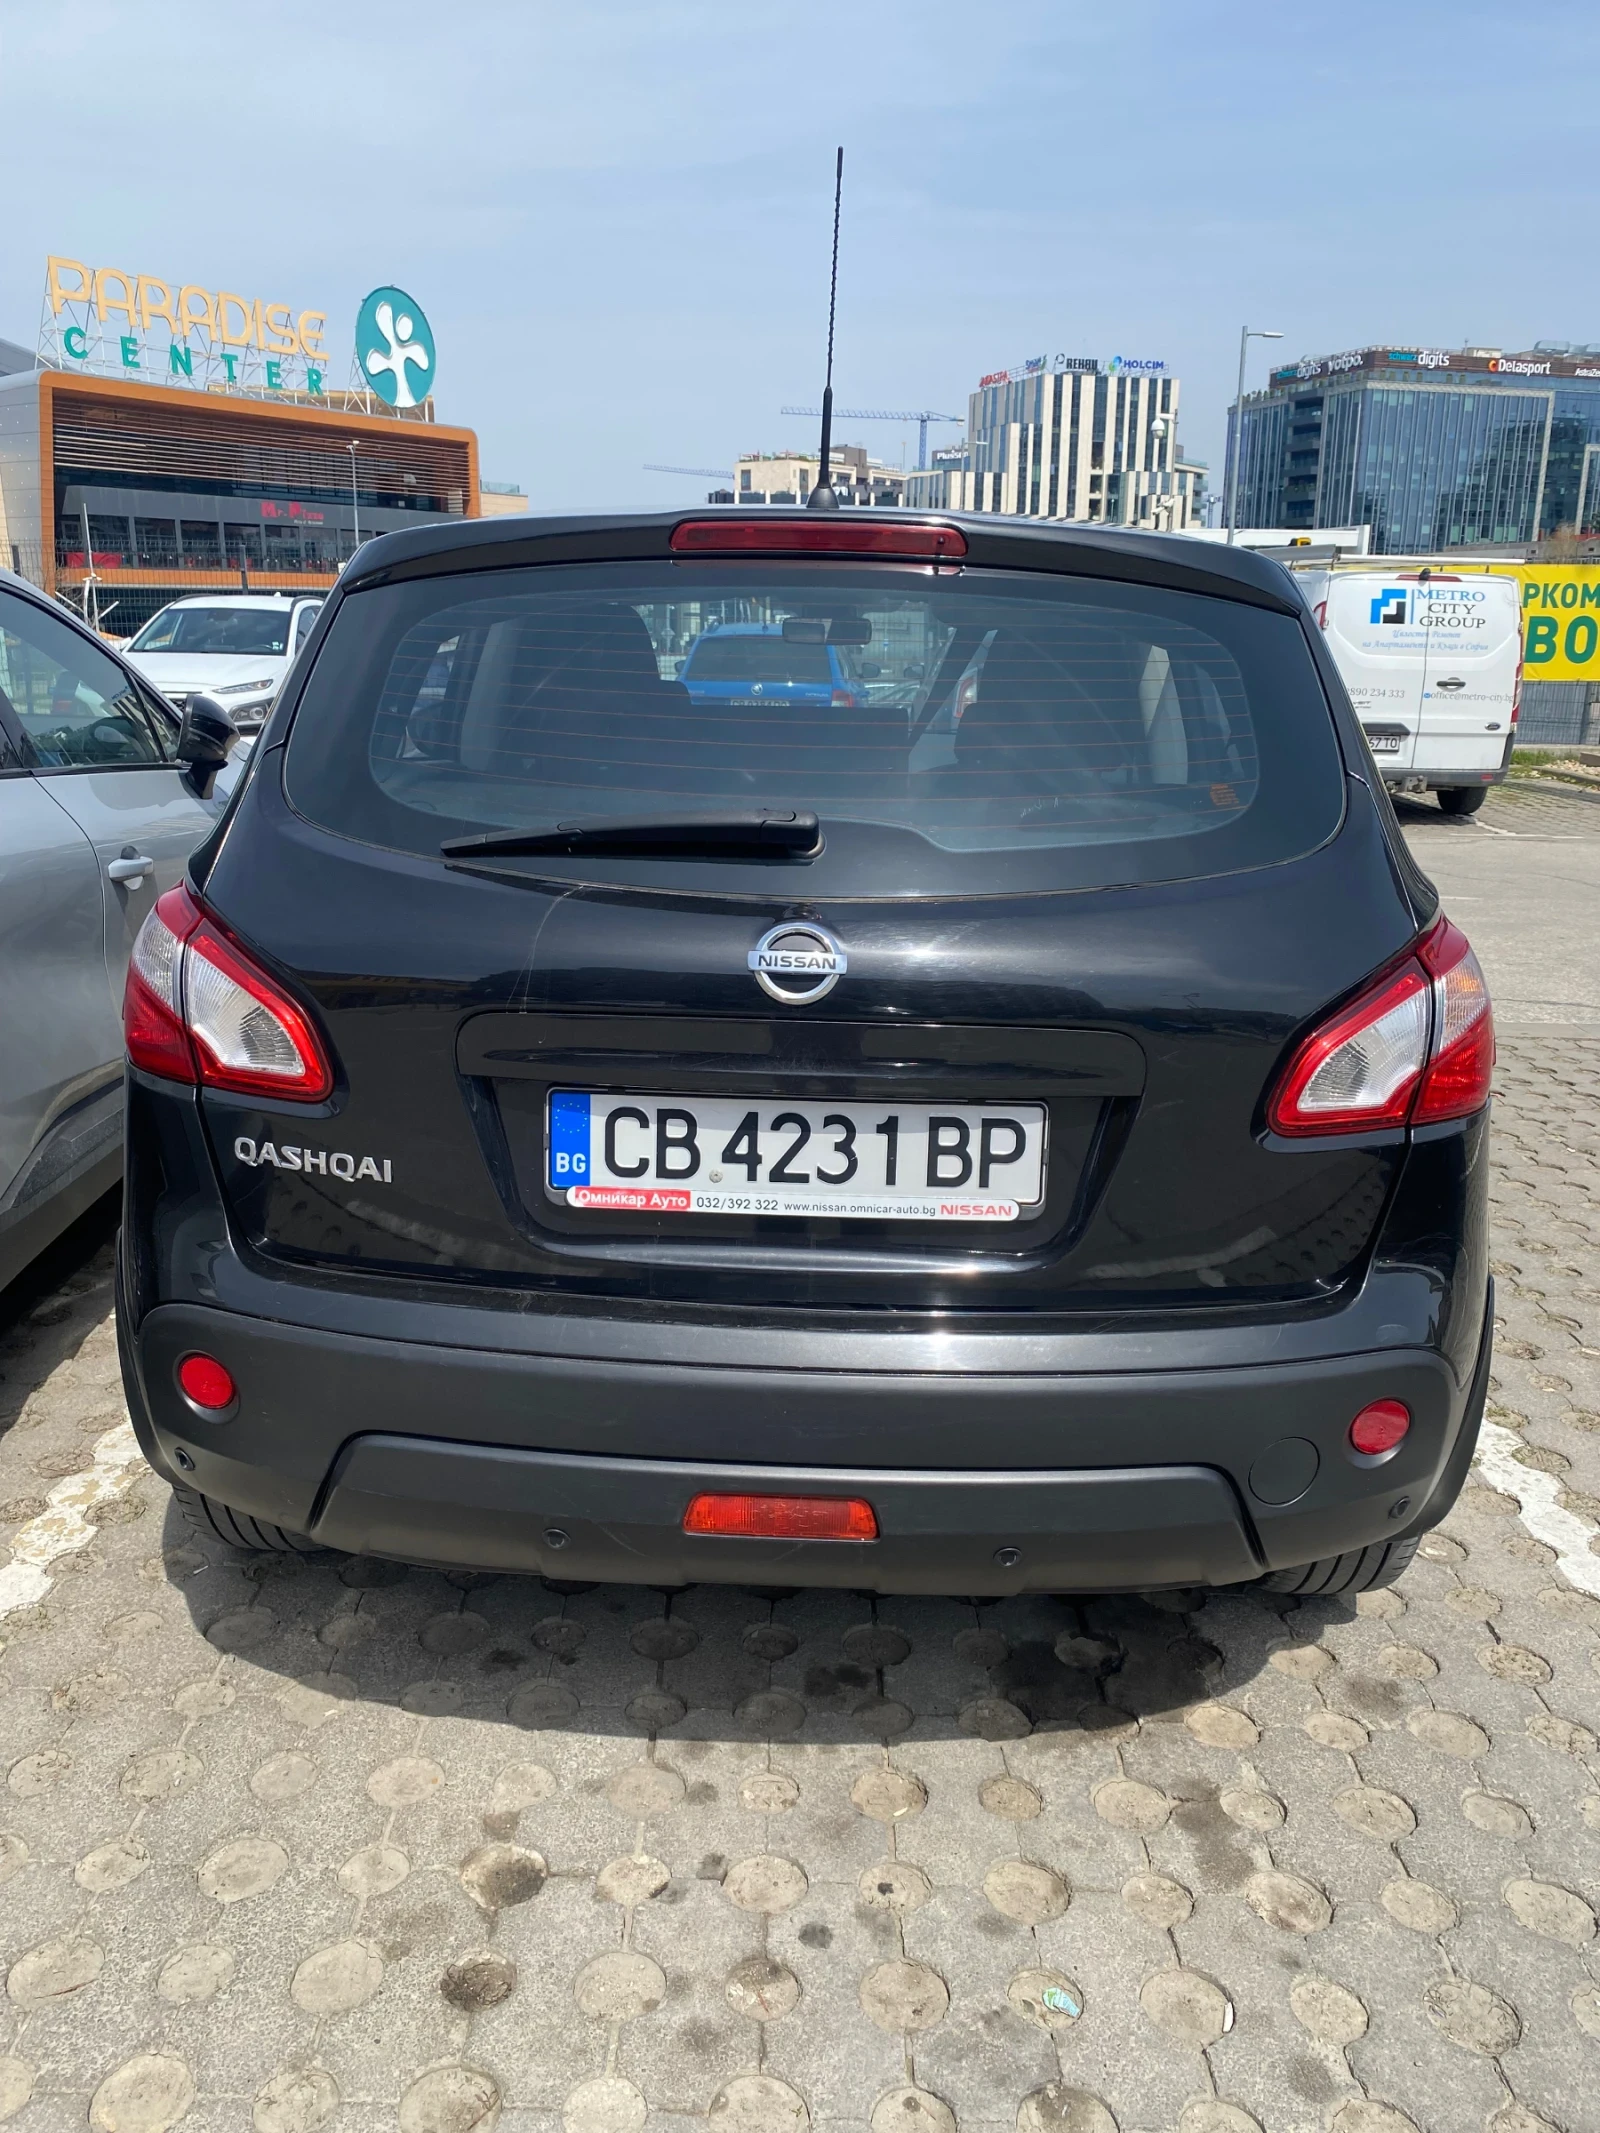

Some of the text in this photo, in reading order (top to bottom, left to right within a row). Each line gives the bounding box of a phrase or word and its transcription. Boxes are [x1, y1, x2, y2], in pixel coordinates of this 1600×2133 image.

[48, 255, 330, 361] PARADISE
[64, 326, 324, 396] CENTER
[1066, 358, 1098, 370] REHAU
[1123, 359, 1164, 369] HOLCIM
[1388, 350, 1450, 369] schwarz digits
[1498, 359, 1551, 376] Delasport
[1416, 589, 1486, 602] METRO
[1428, 603, 1476, 614] CITY
[1419, 616, 1486, 628] GROUP
[1524, 615, 1599, 664] ВО
[1370, 688, 1387, 697] 234
[1389, 689, 1406, 698] 333
[1431, 689, 1514, 704] office@metro-city.bg
[758, 955, 836, 970] NISSAN
[604, 1106, 1027, 1189] CB 4231 BP
[234, 1136, 392, 1183] QASHQAI
[555, 1152, 587, 1174] BG
[578, 1189, 688, 1209] Омникар Ауто
[696, 1195, 1012, 1218] 032/392 322 www.nissan.omnicar-auto.bg NISSAN
